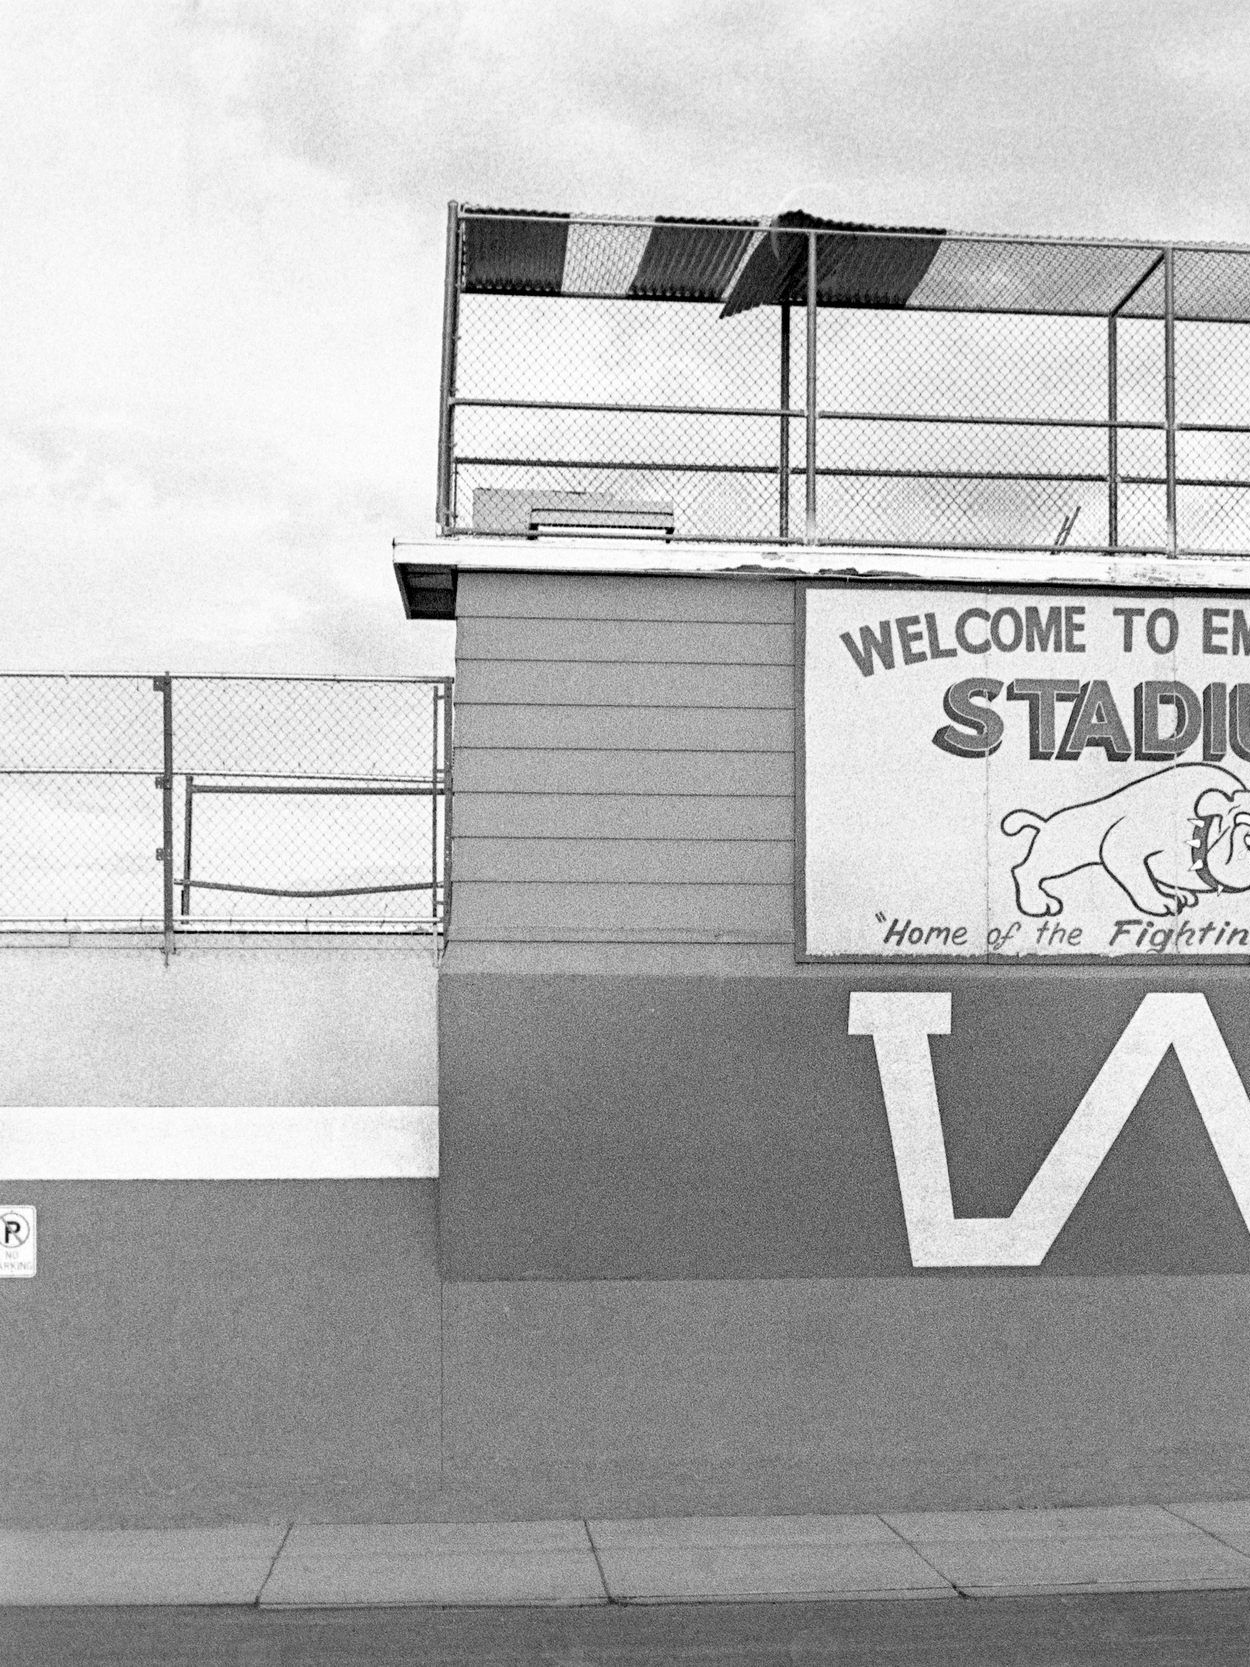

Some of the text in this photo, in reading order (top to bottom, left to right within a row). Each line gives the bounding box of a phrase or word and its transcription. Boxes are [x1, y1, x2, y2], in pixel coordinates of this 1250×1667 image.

[840, 606, 1085, 677] WELCOME
[1113, 608, 1178, 654] TO
[875, 911, 968, 946] "Home
[986, 921, 1021, 950] of
[1036, 920, 1083, 945] the
